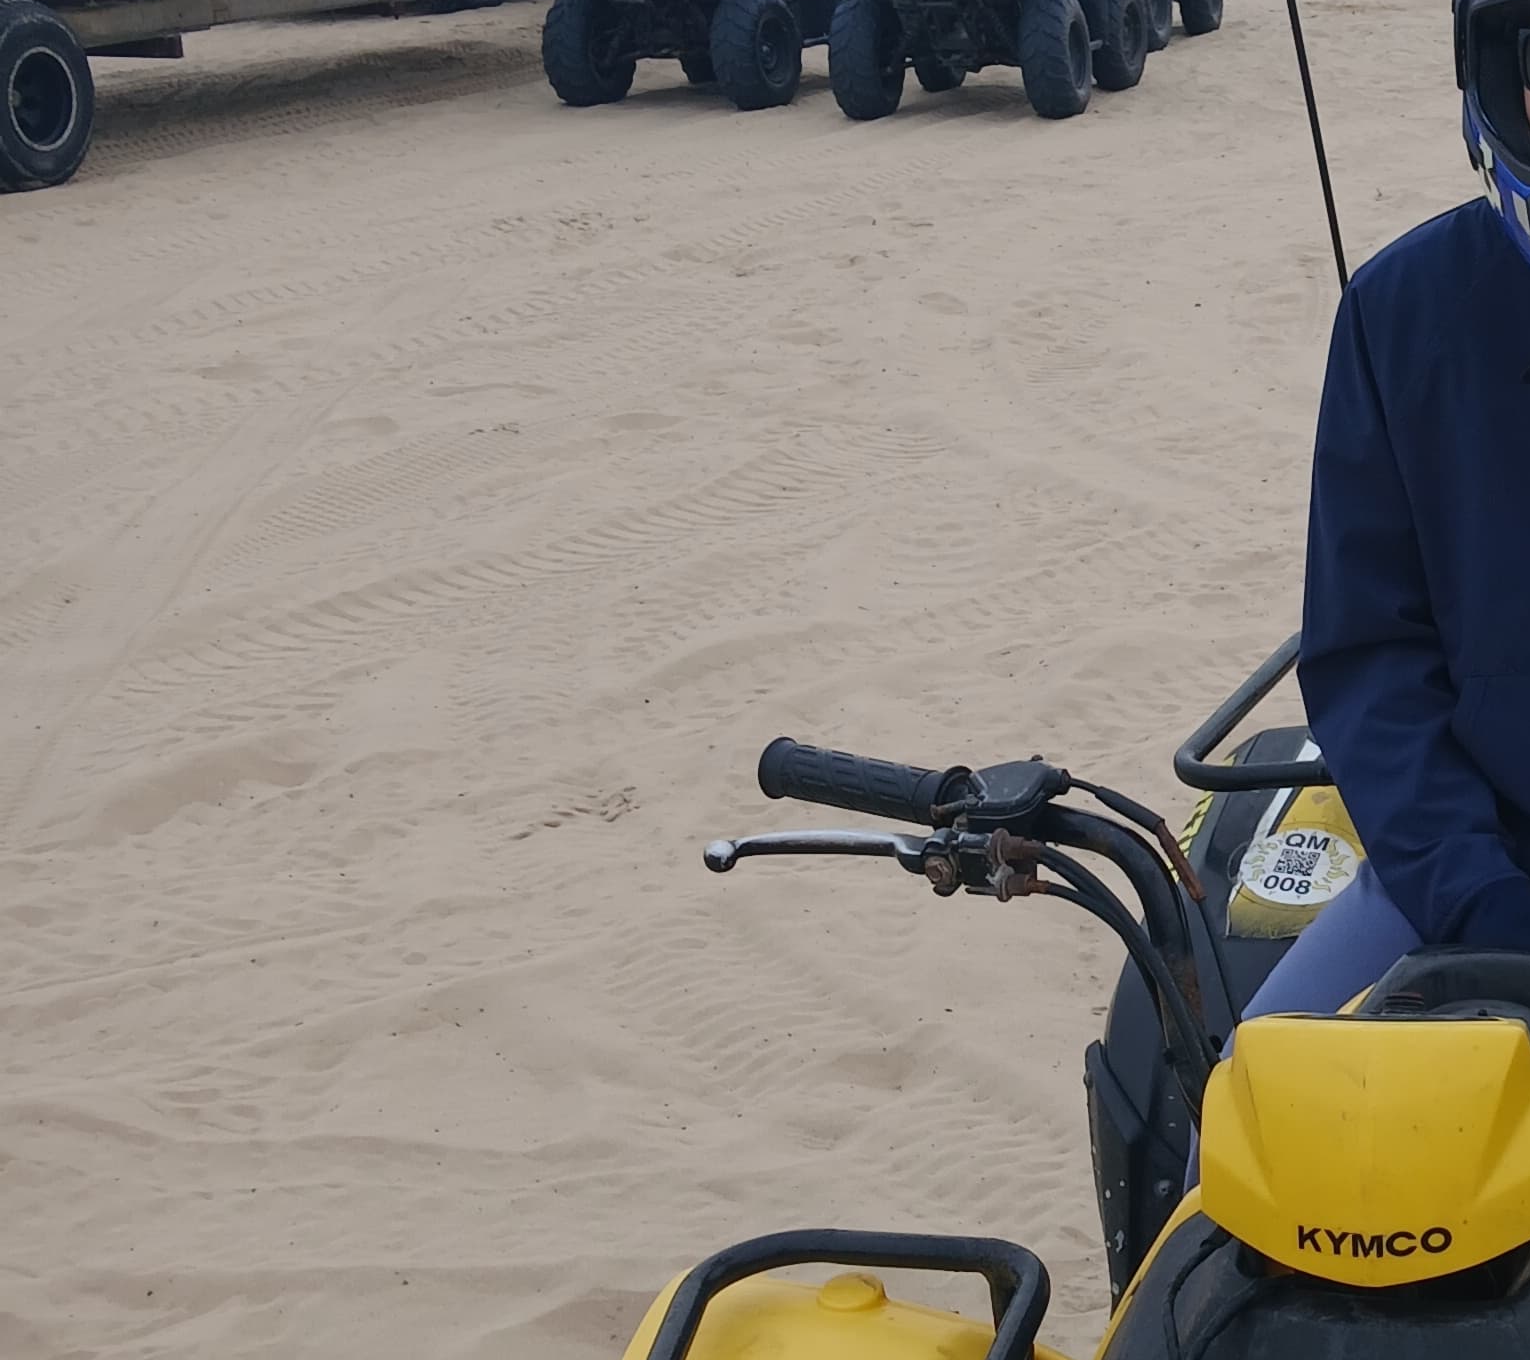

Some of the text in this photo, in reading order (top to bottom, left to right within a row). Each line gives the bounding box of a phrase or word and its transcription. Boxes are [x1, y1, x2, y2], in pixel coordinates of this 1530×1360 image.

[1285, 832, 1331, 852] QM
[1263, 874, 1313, 895] 008
[1297, 1224, 1453, 1259] KYMCO
